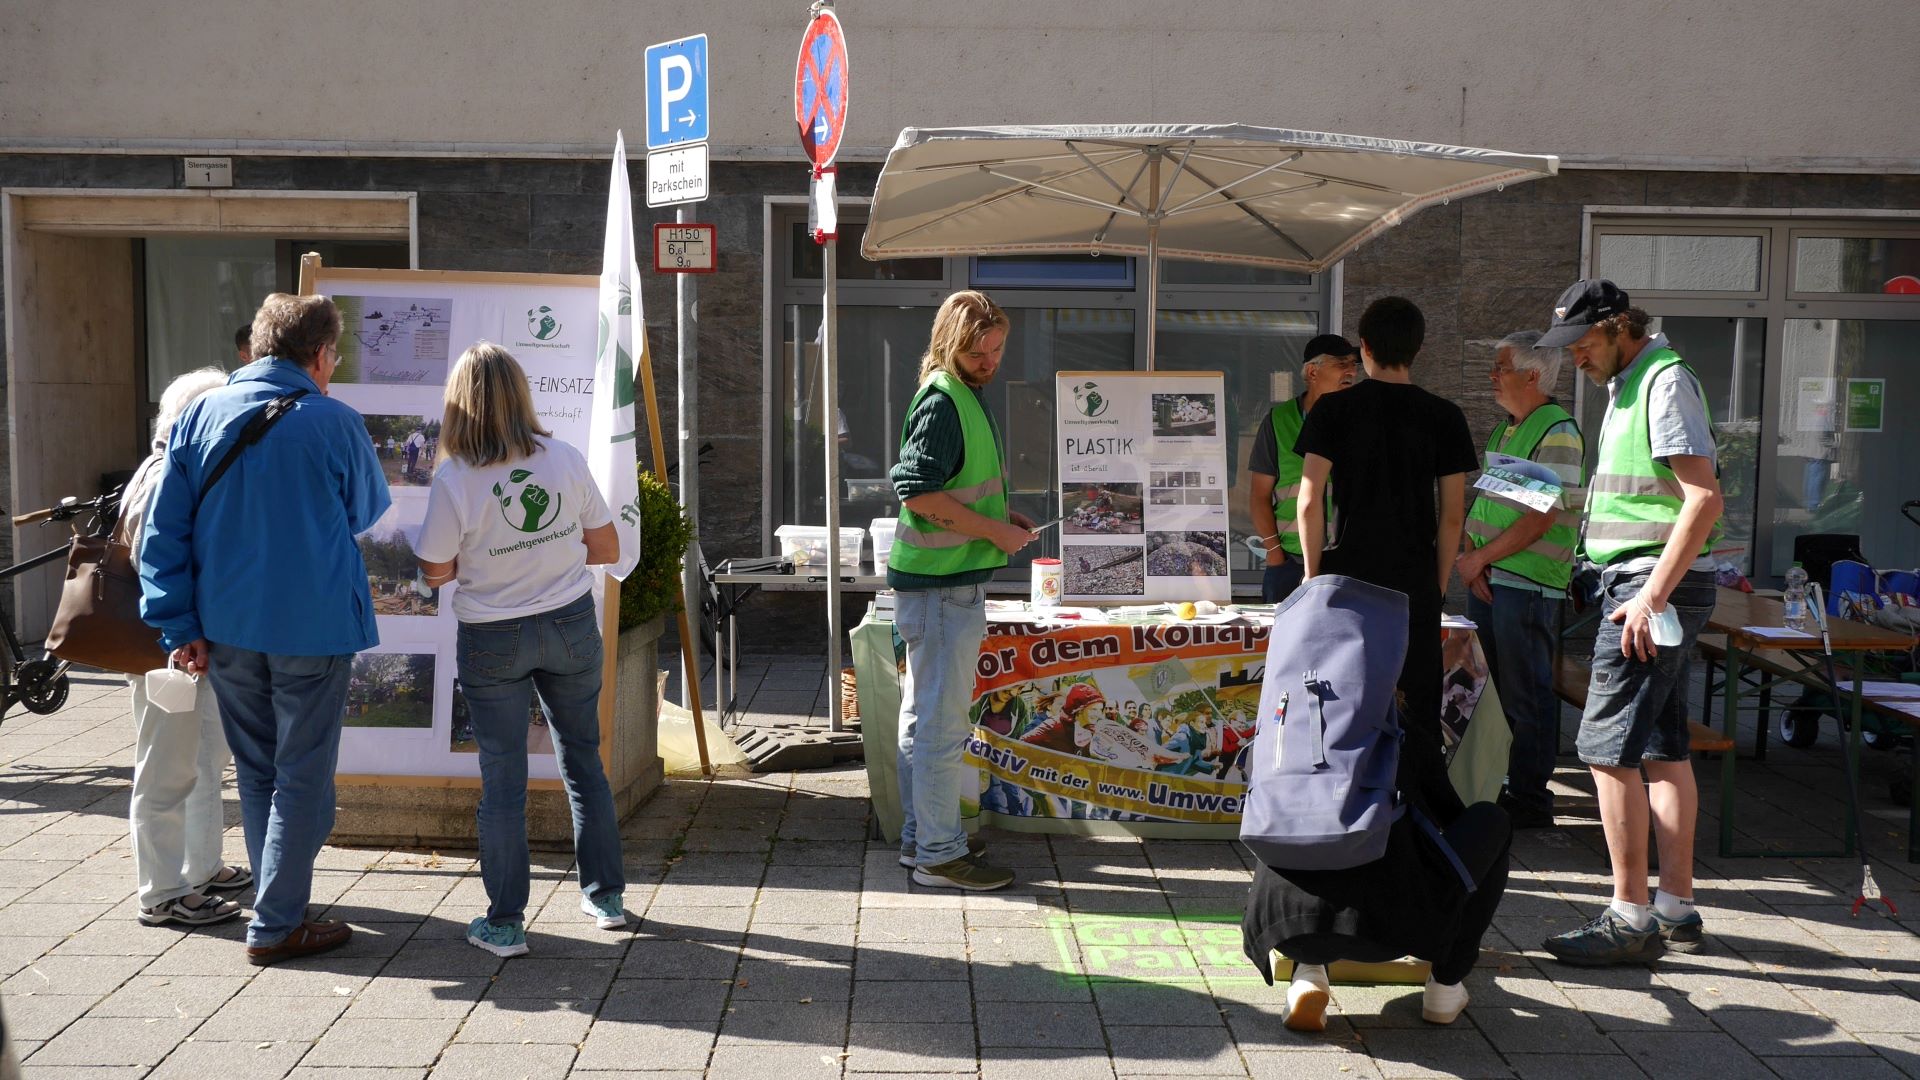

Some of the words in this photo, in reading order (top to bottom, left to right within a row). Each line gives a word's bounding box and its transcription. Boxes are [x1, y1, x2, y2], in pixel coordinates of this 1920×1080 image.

[659, 54, 693, 133] P
[188, 161, 228, 170] Sterngasse
[669, 161, 685, 174] mit
[204, 171, 211, 182] 1
[652, 177, 703, 194] Parkschein
[669, 229, 700, 240] H150
[515, 341, 571, 349] Umweltgewerkschaft
[1066, 438, 1134, 455] PLASTIK
[489, 522, 578, 557] Umweltgewerkschaft
[976, 647, 1017, 678] or
[1031, 636, 1119, 666] dem
[1132, 625, 1269, 651] Kollap
[1030, 767, 1058, 782] mit
[1061, 774, 1089, 789] der
